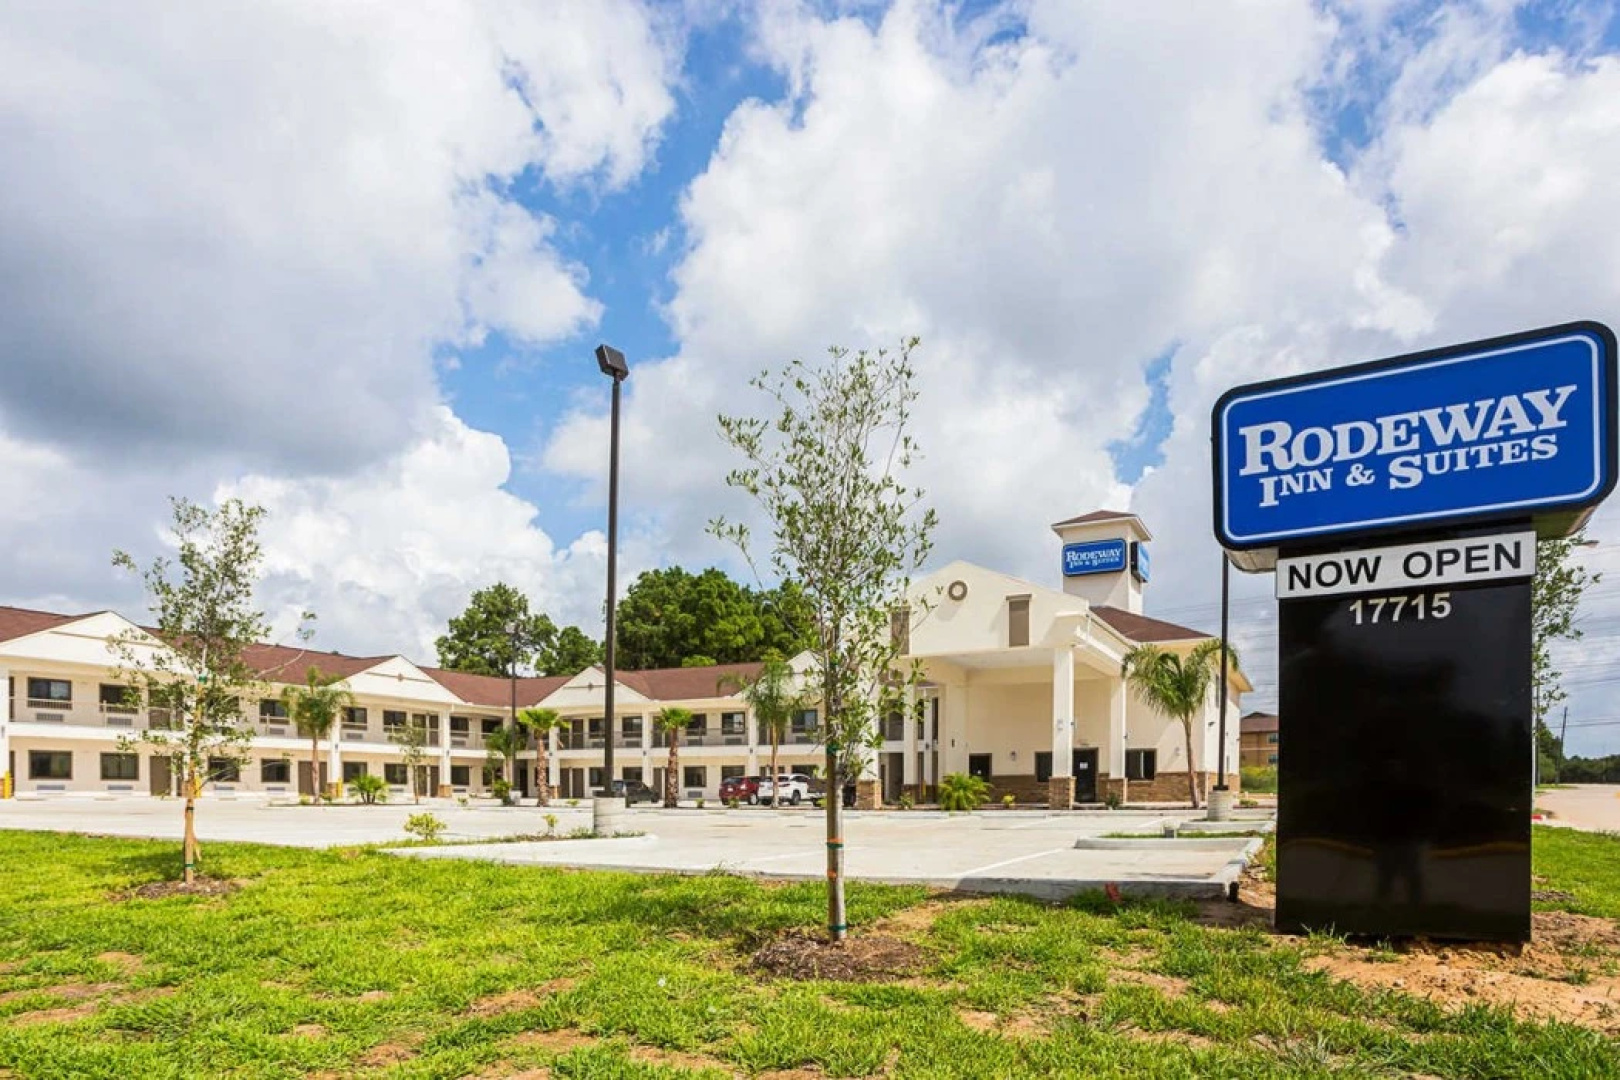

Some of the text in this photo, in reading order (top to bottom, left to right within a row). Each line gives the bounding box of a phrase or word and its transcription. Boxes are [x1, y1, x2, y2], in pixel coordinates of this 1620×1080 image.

[1239, 384, 1578, 476] RODEWAY
[1258, 434, 1558, 507] INN & SUITES
[1066, 548, 1122, 562] RODEWAY
[1288, 541, 1522, 591] NOW OPEN
[1349, 592, 1452, 625] 17715
